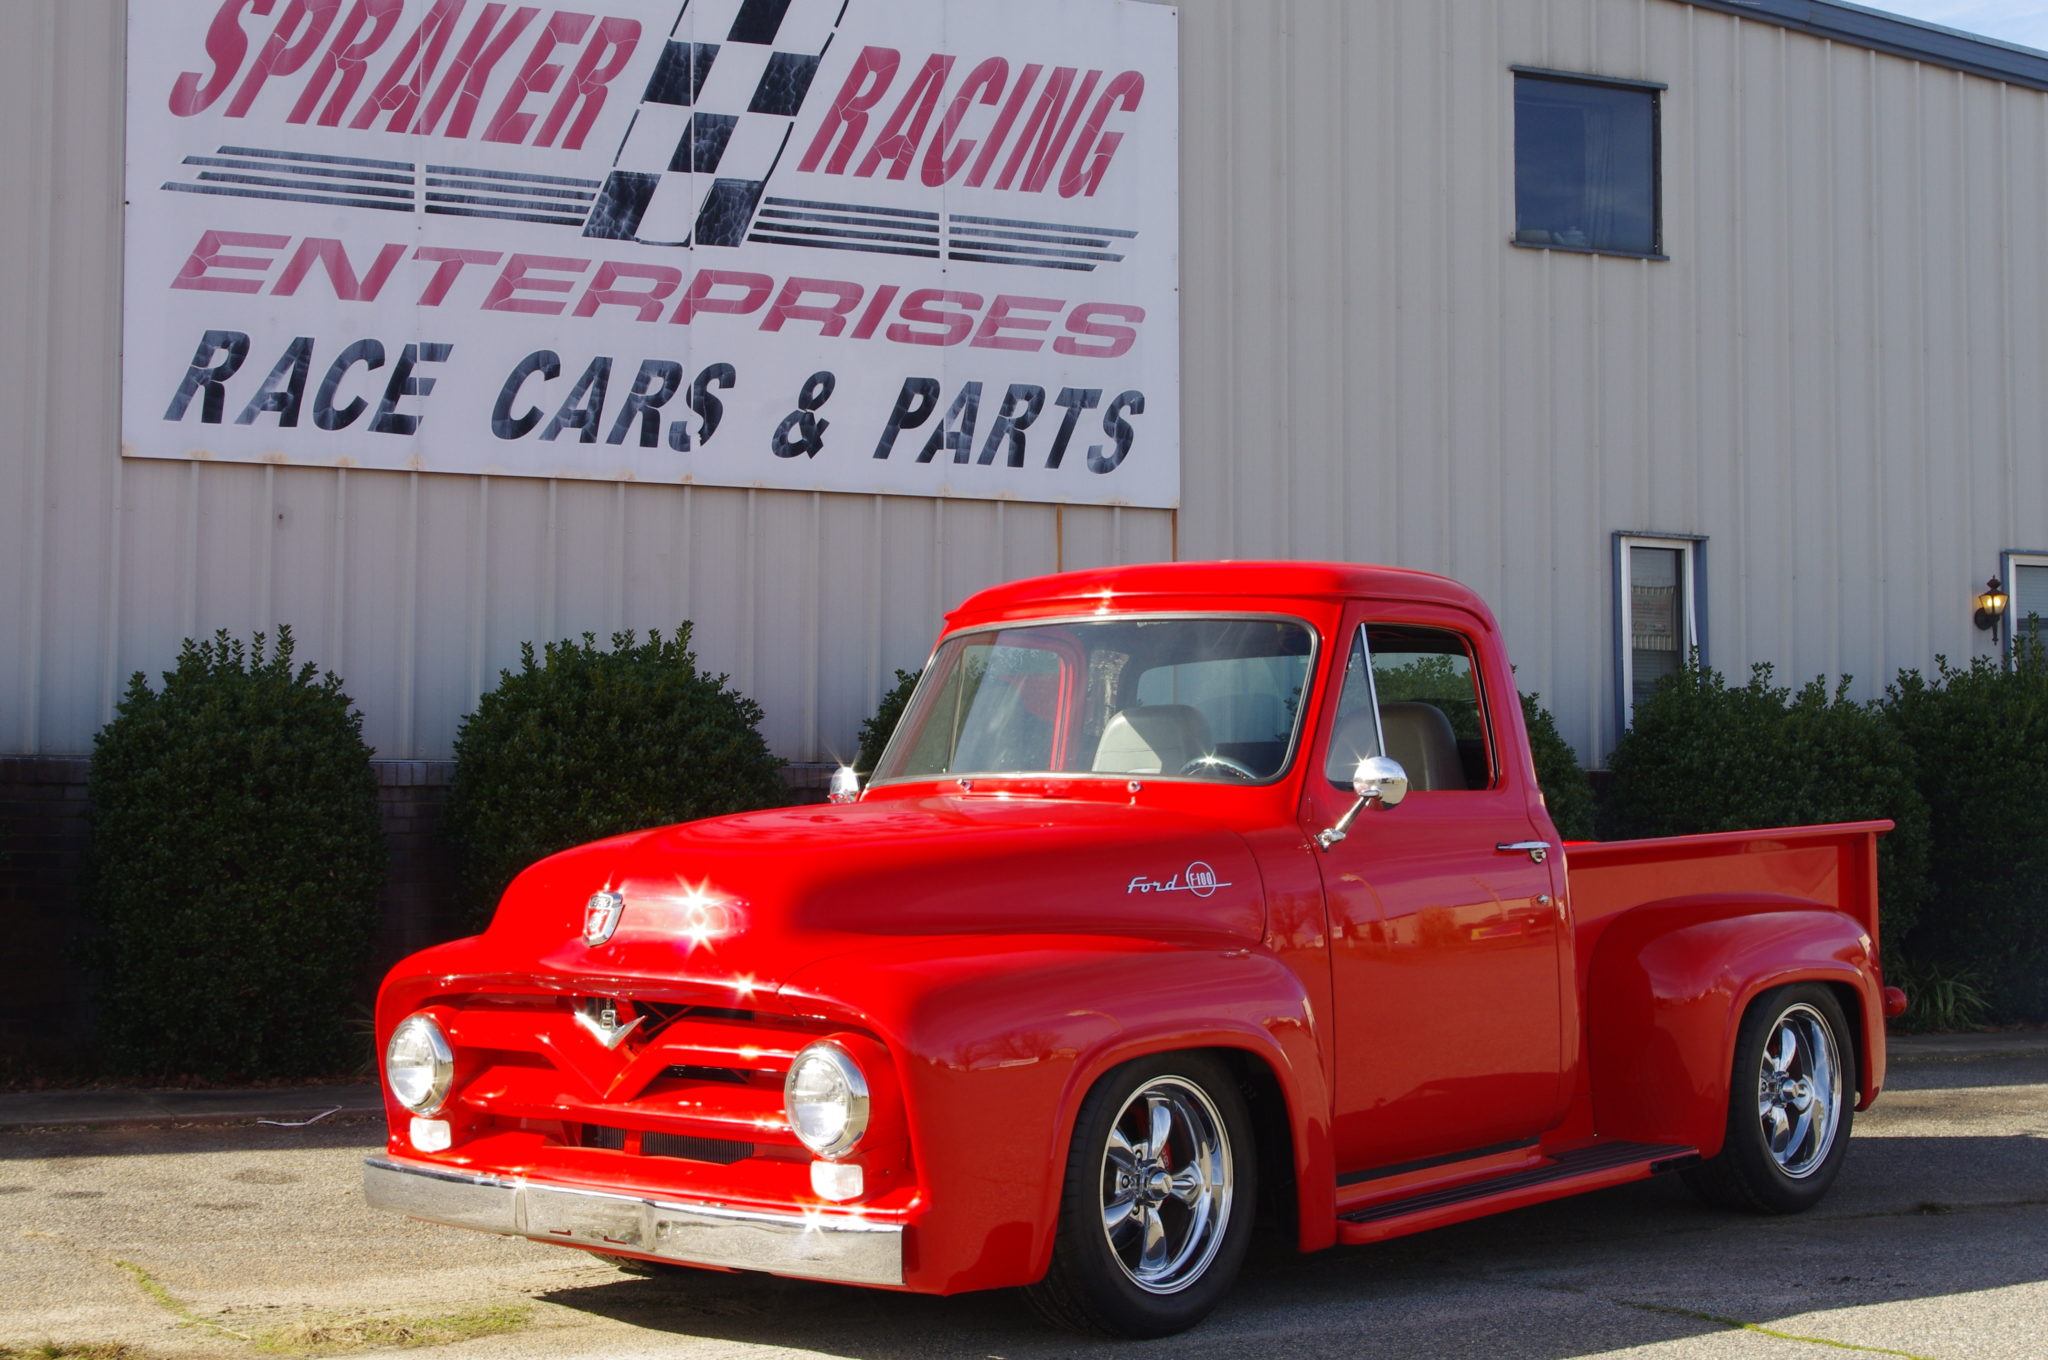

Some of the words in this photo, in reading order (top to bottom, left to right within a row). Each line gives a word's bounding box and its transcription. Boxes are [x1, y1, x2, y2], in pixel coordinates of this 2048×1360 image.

[168, 0, 643, 151] SPRAKER
[796, 45, 1145, 199] RACING
[169, 229, 1147, 359] ENTERPRISES
[162, 329, 454, 437] RACE
[491, 349, 736, 454] CARS
[771, 370, 836, 460] &
[872, 376, 1146, 475] PARTS
[1127, 873, 1179, 894] Ford
